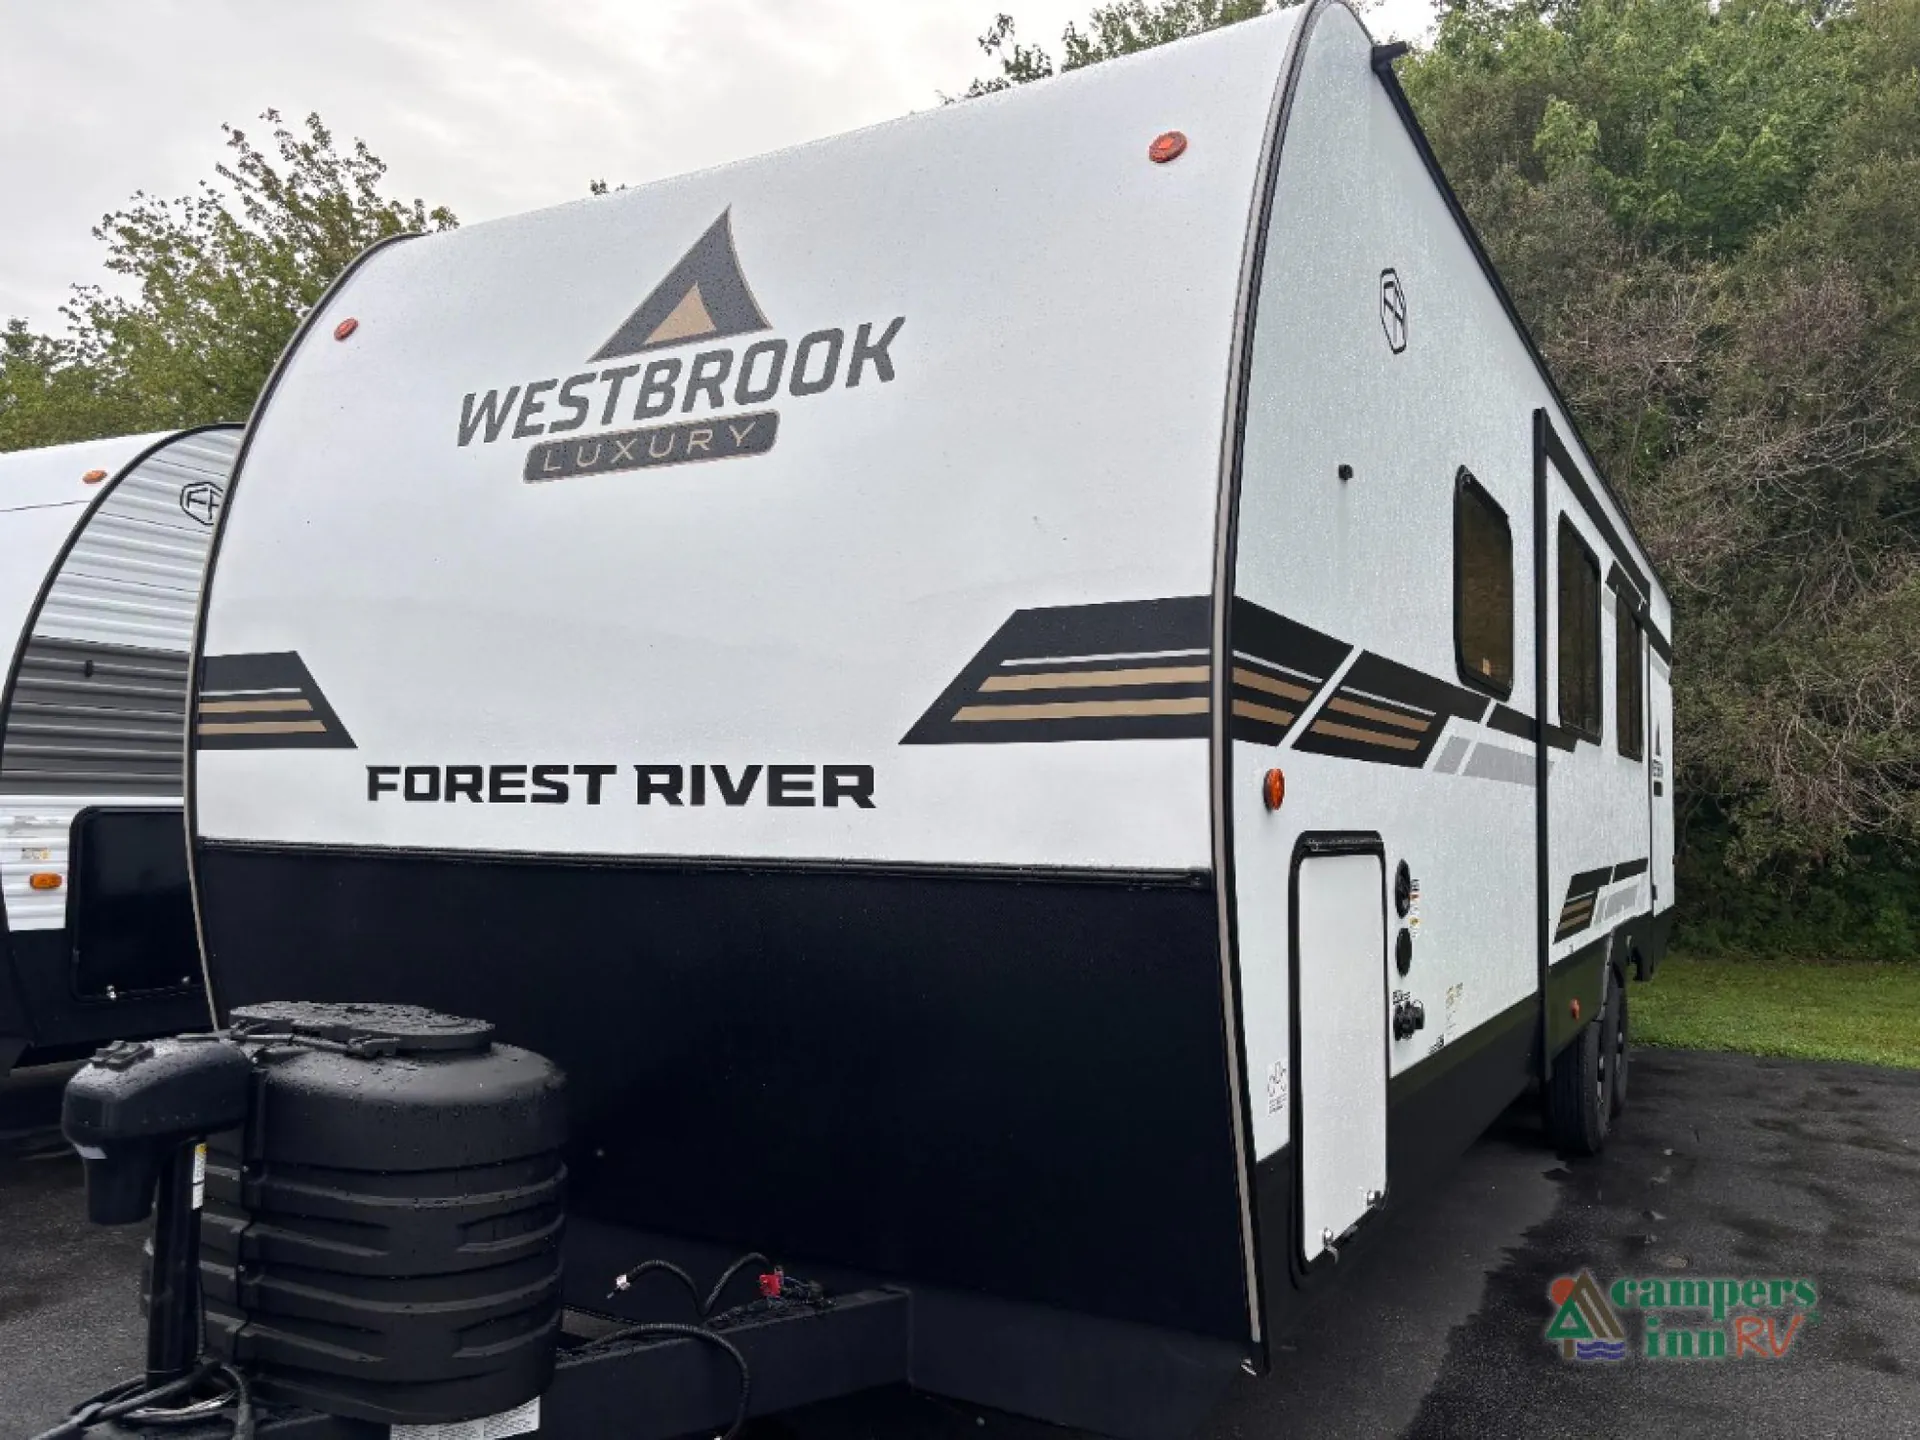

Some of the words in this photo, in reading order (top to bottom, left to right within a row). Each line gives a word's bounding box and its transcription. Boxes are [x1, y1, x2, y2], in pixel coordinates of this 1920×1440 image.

[457, 316, 906, 447] WESTBROOK
[541, 421, 756, 472] LUXURY
[366, 765, 617, 804] FOREST
[634, 765, 876, 808] RIVER
